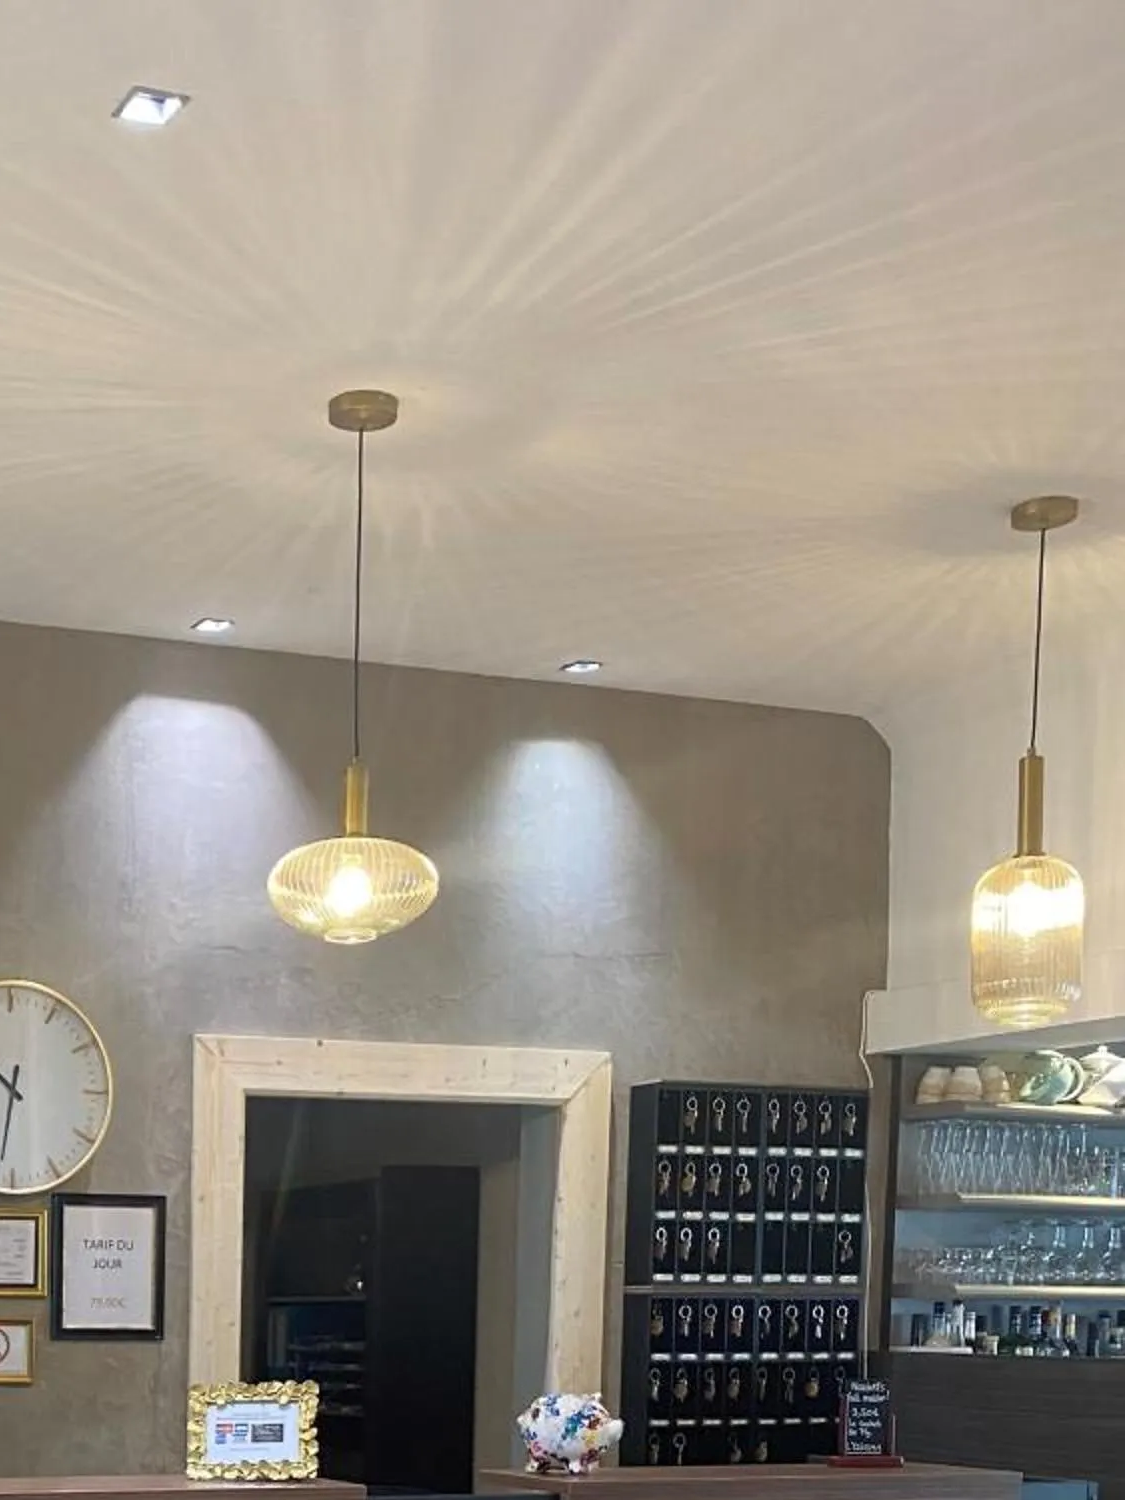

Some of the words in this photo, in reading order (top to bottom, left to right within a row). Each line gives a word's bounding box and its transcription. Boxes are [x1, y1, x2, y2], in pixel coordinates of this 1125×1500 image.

[82, 1238, 115, 1250] TARIF
[116, 1239, 135, 1251] DU
[91, 1258, 123, 1270] JOUR
